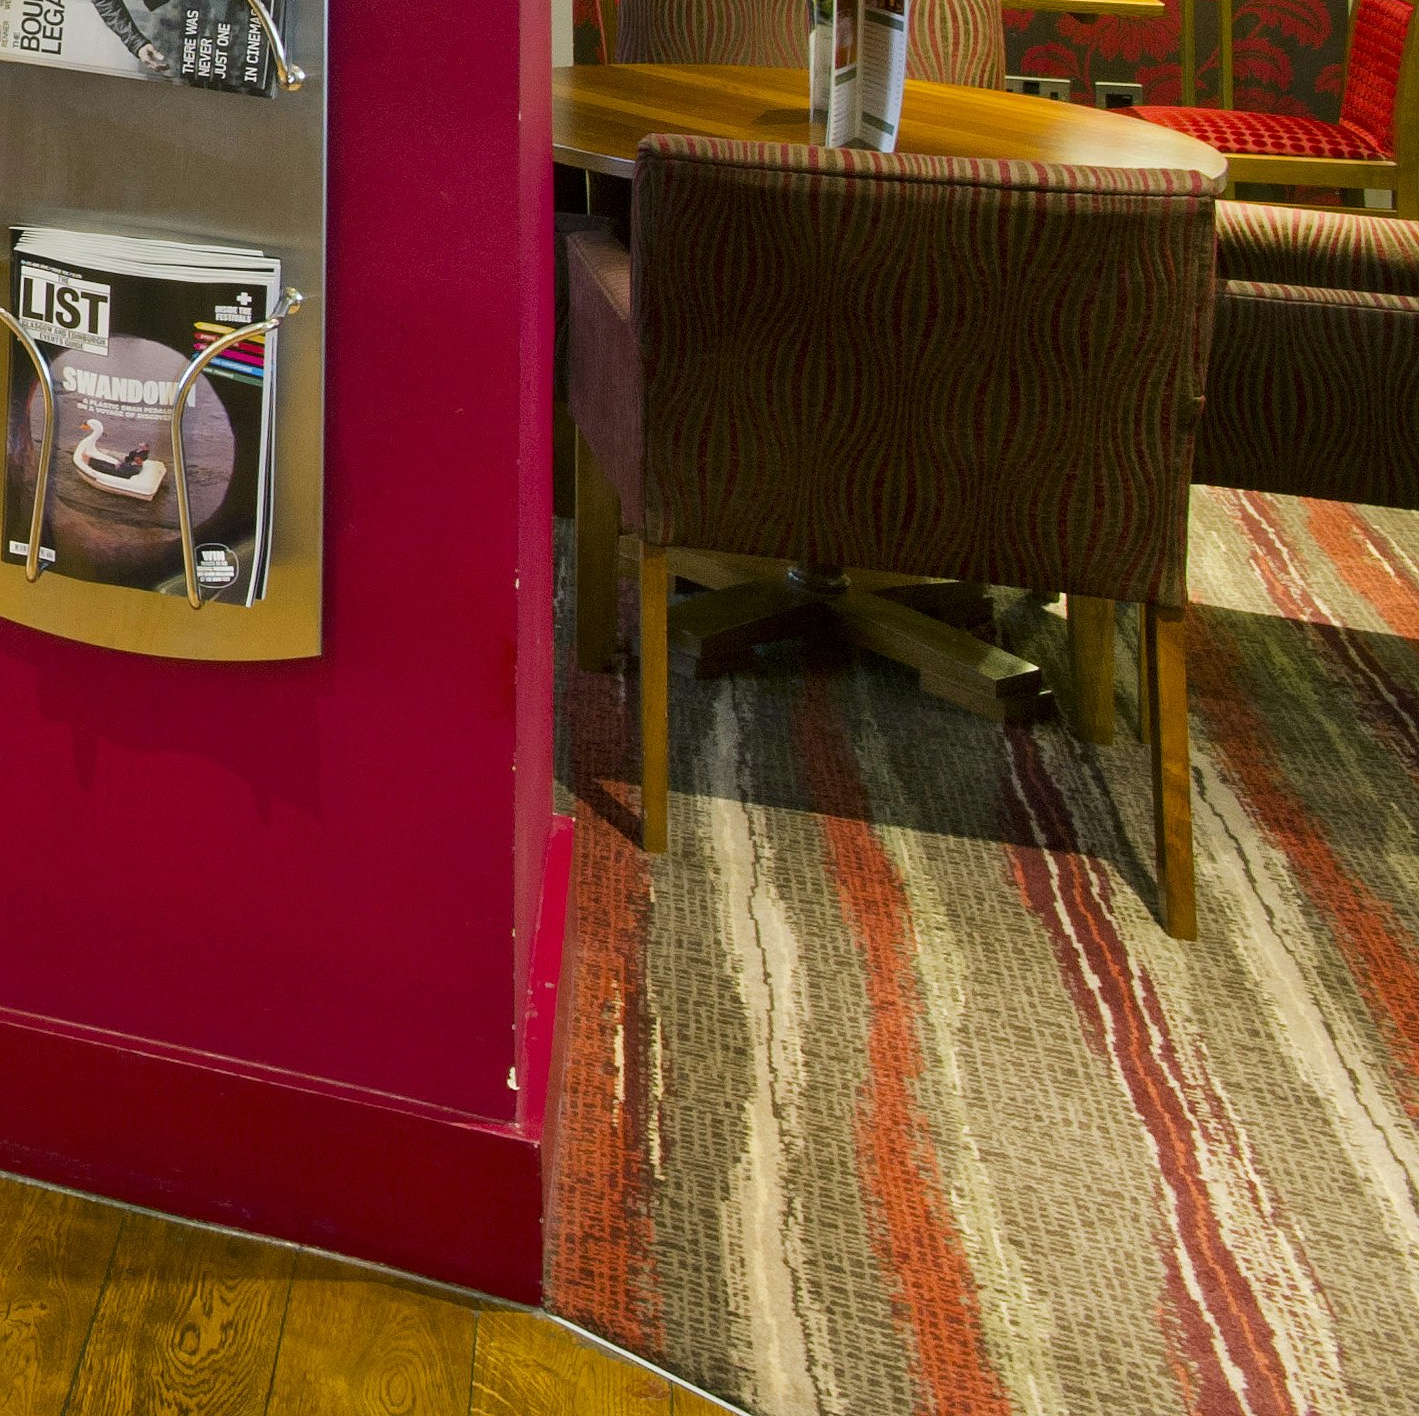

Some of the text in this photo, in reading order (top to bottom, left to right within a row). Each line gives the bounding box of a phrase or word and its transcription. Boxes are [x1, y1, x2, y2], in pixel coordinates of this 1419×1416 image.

[12, 32, 21, 48] THE
[182, 9, 199, 74] THERE WAS
[198, 38, 213, 77] NEVER
[214, 23, 231, 79] JUST ONE
[244, 66, 258, 83] IN
[22, 277, 109, 335] LIST
[201, 550, 226, 561] WIN
